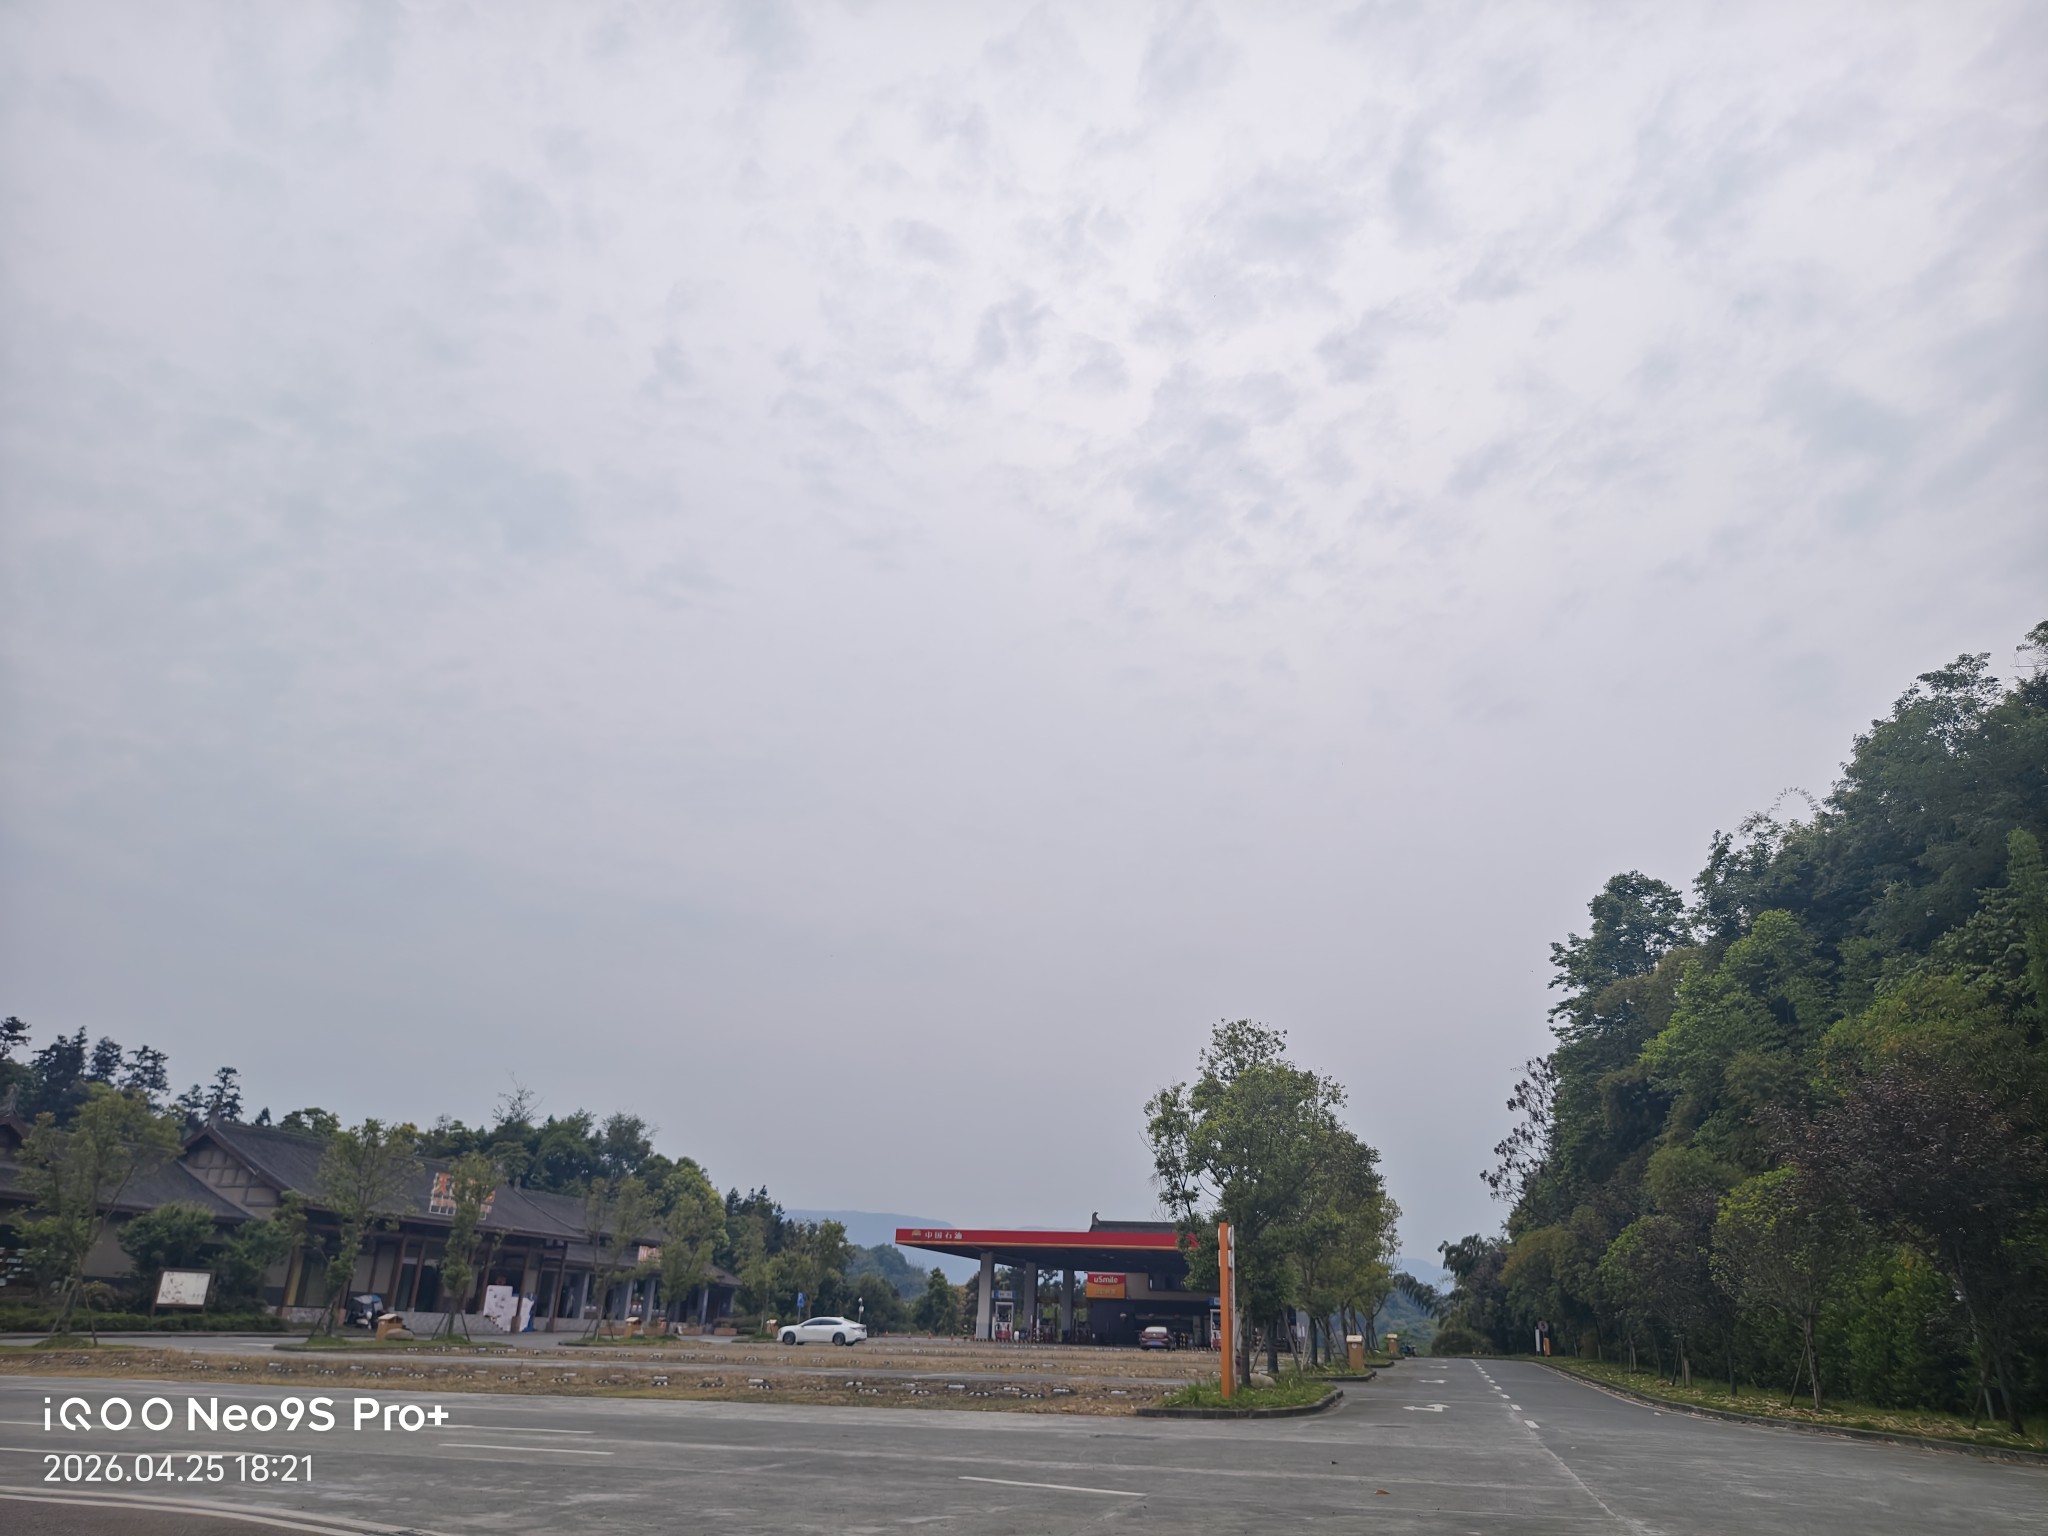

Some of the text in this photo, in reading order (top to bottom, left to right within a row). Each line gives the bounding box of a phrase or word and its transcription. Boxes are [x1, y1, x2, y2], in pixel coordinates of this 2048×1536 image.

[924, 1231, 962, 1240] 中国石油
[1093, 1275, 1119, 1284] uSmile
